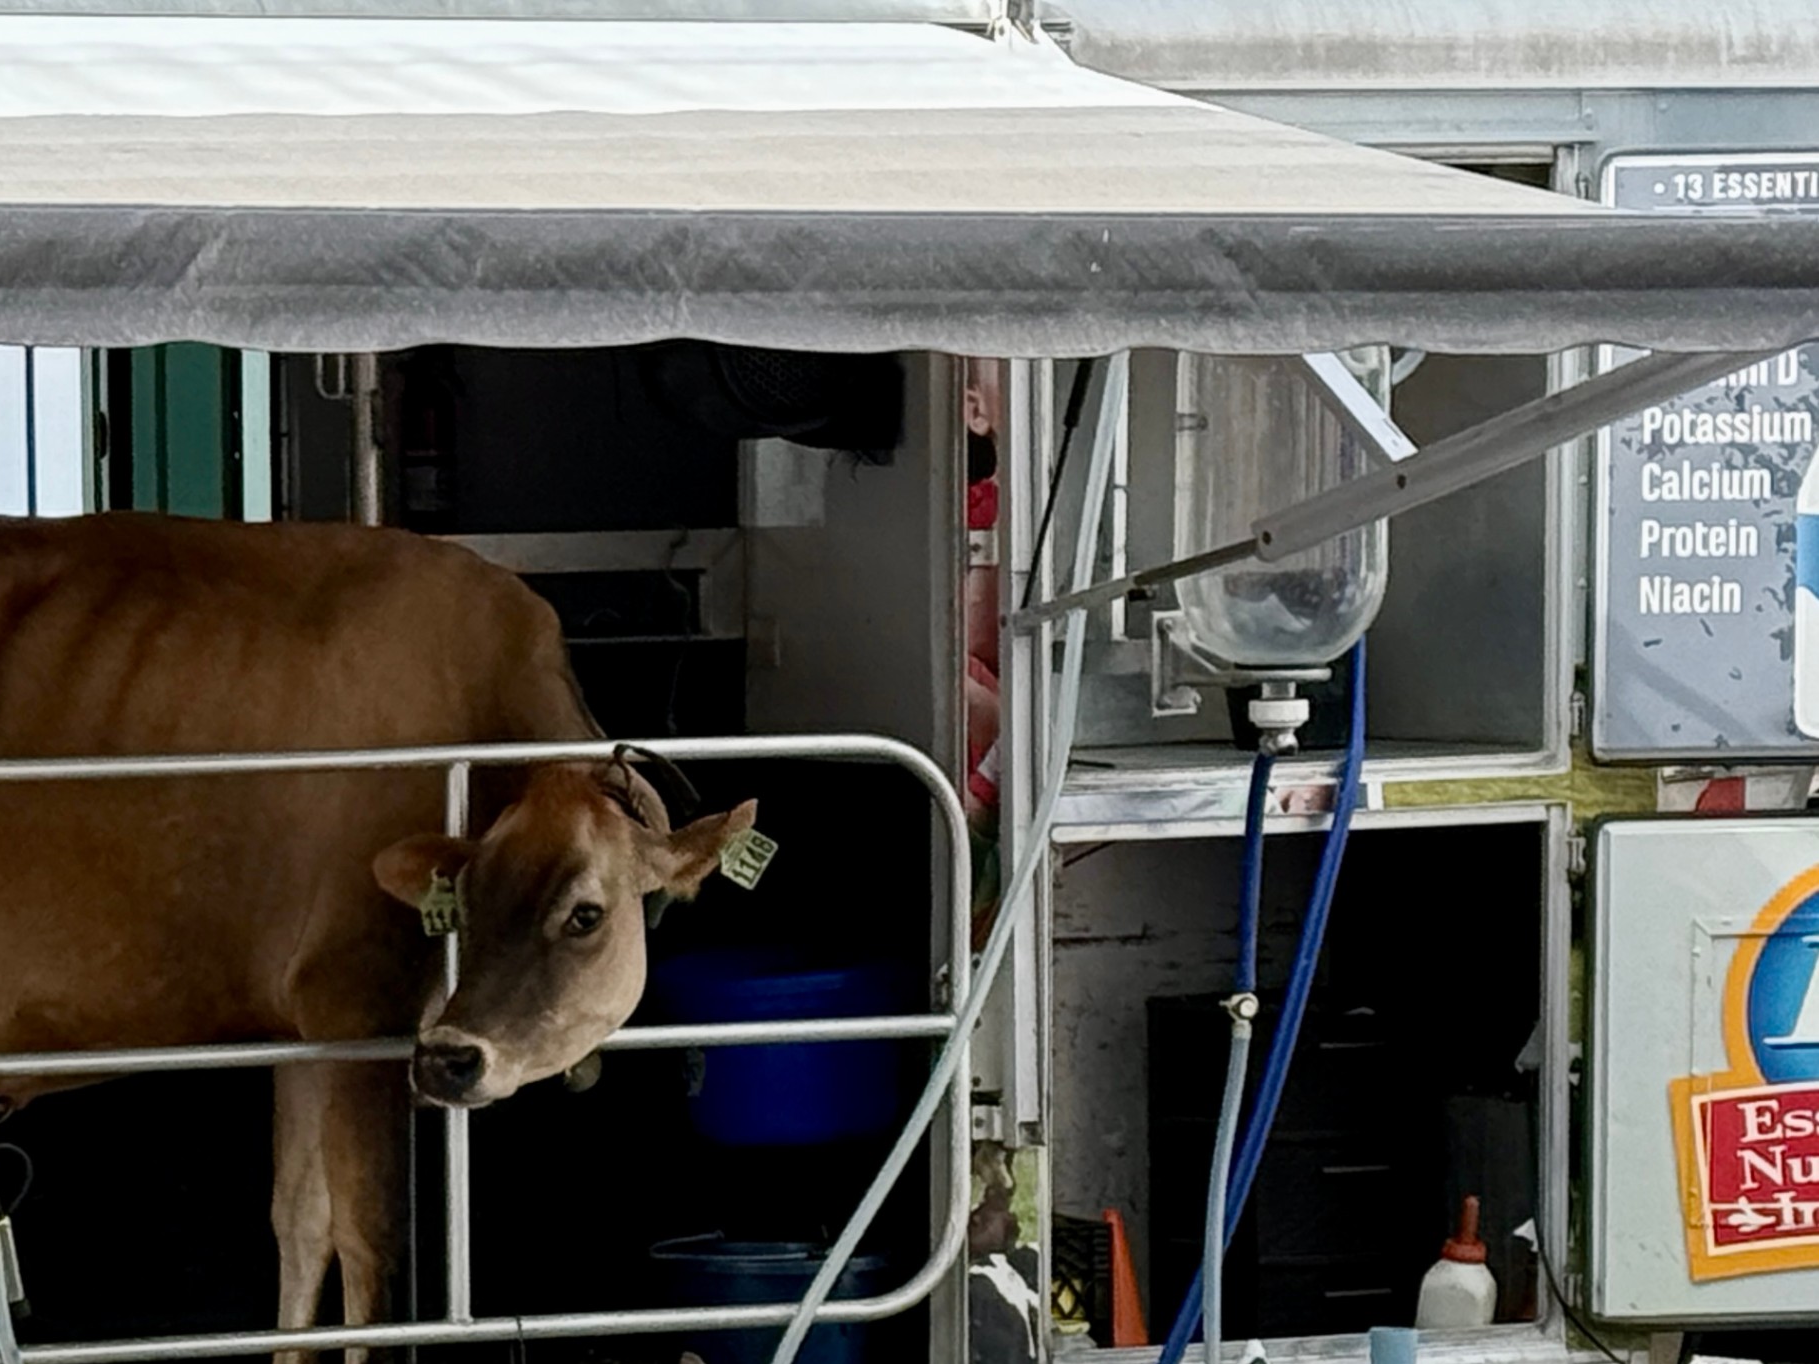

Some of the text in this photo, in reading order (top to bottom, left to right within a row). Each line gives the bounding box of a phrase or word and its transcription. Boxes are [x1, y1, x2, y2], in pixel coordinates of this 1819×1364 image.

[1674, 170, 1819, 200] 13 ESSENTI
[1642, 403, 1812, 444] Potassium
[1641, 459, 1772, 501] Calcium
[1639, 517, 1759, 558] Protein
[1639, 574, 1742, 614] Niacin
[1736, 1099, 1819, 1143] Es
